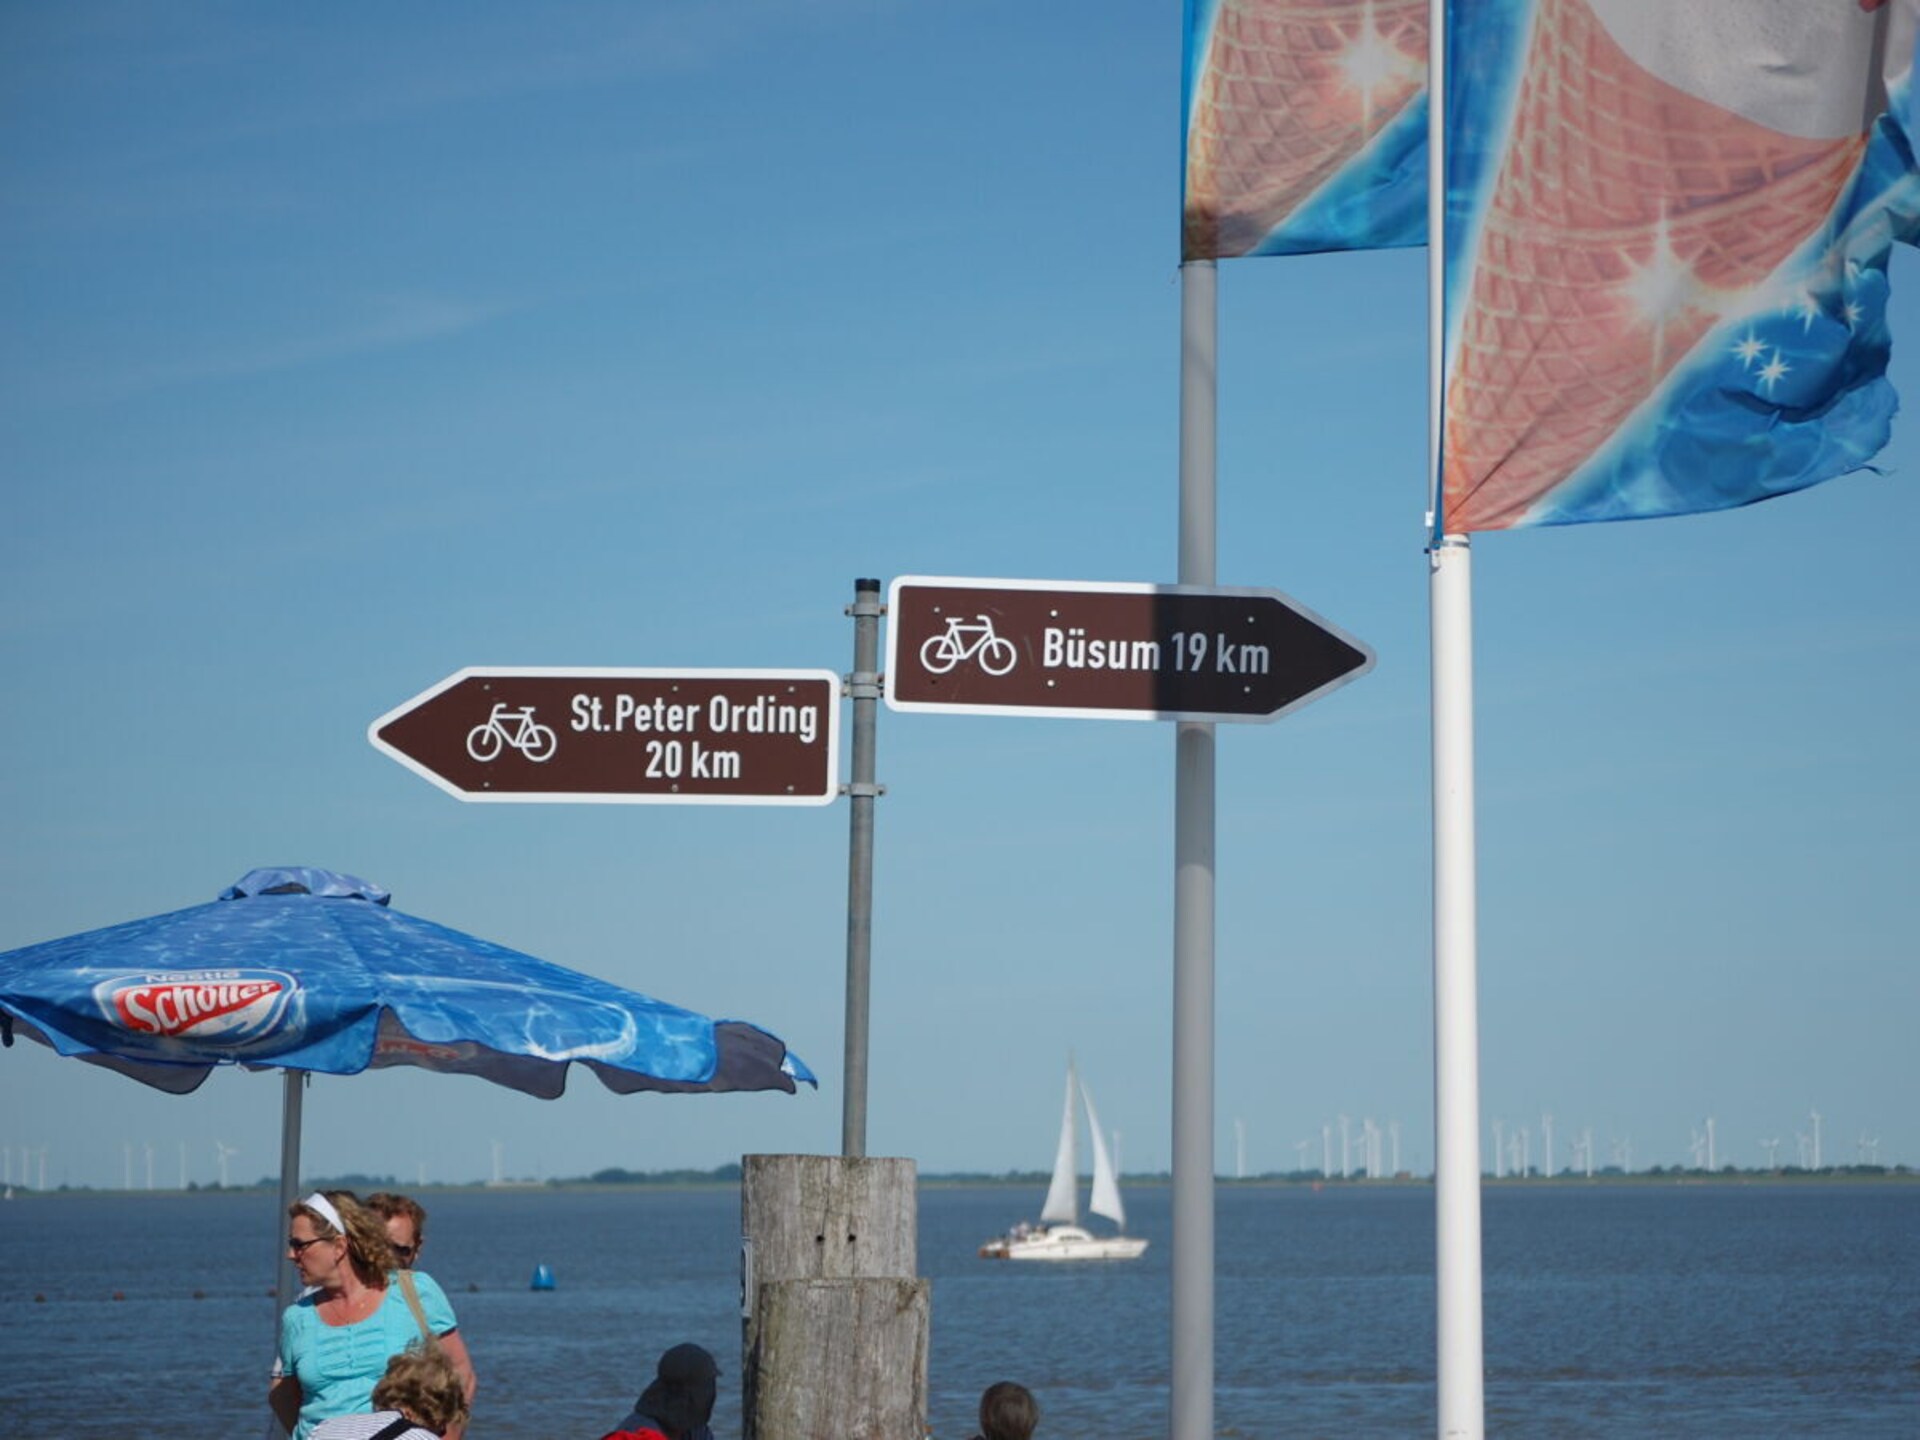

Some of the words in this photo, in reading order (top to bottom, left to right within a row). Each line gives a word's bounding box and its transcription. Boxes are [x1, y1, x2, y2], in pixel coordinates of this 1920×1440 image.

[1043, 627, 1160, 671] Büsum
[1171, 632, 1208, 672] 19
[1216, 634, 1270, 674] km
[709, 695, 818, 743] Ording
[645, 741, 683, 778] 20
[691, 741, 740, 778] km
[125, 981, 277, 1034] Schöller
